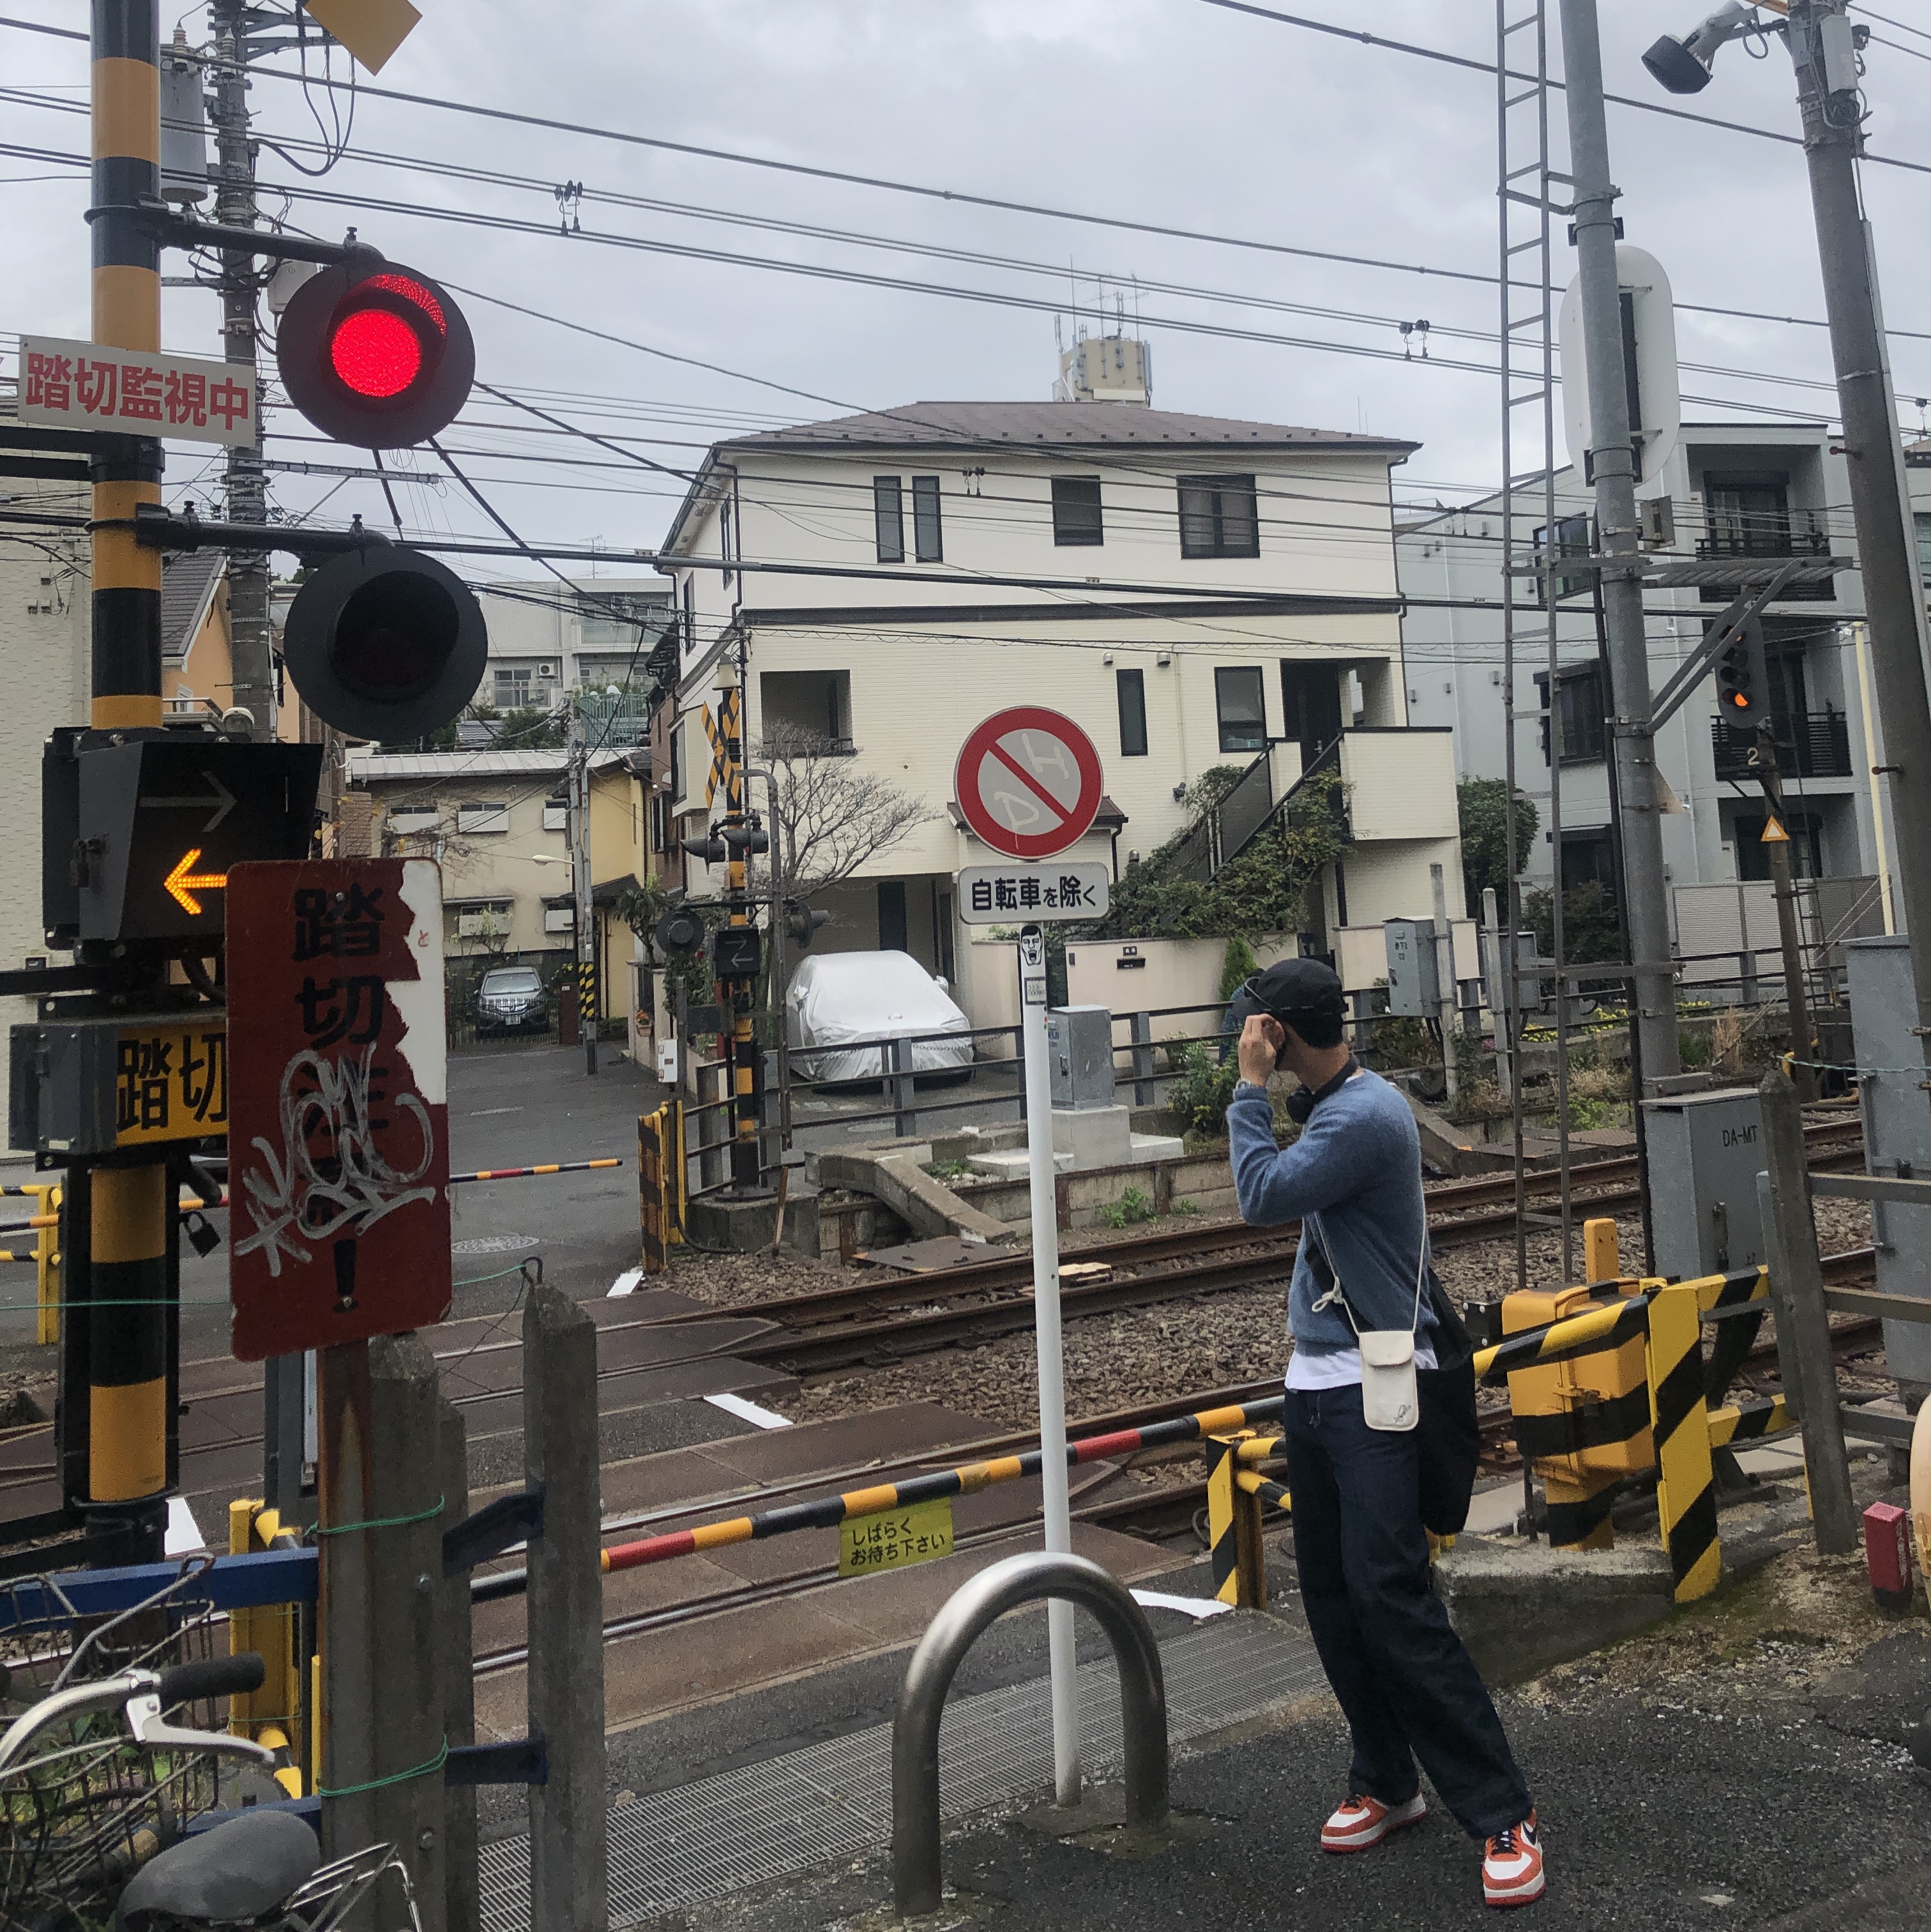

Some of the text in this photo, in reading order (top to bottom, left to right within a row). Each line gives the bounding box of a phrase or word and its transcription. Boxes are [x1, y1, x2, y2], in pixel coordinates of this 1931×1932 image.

[26, 353, 248, 430] 踏切監視中
[1747, 747, 1760, 766] 2
[971, 875, 1096, 911] 自転車を除く
[117, 1031, 227, 1134] 踏切
[1722, 1124, 1758, 1148] DA-MT
[852, 1517, 912, 1546] しばらく
[851, 1534, 945, 1566] お待ち下さい
